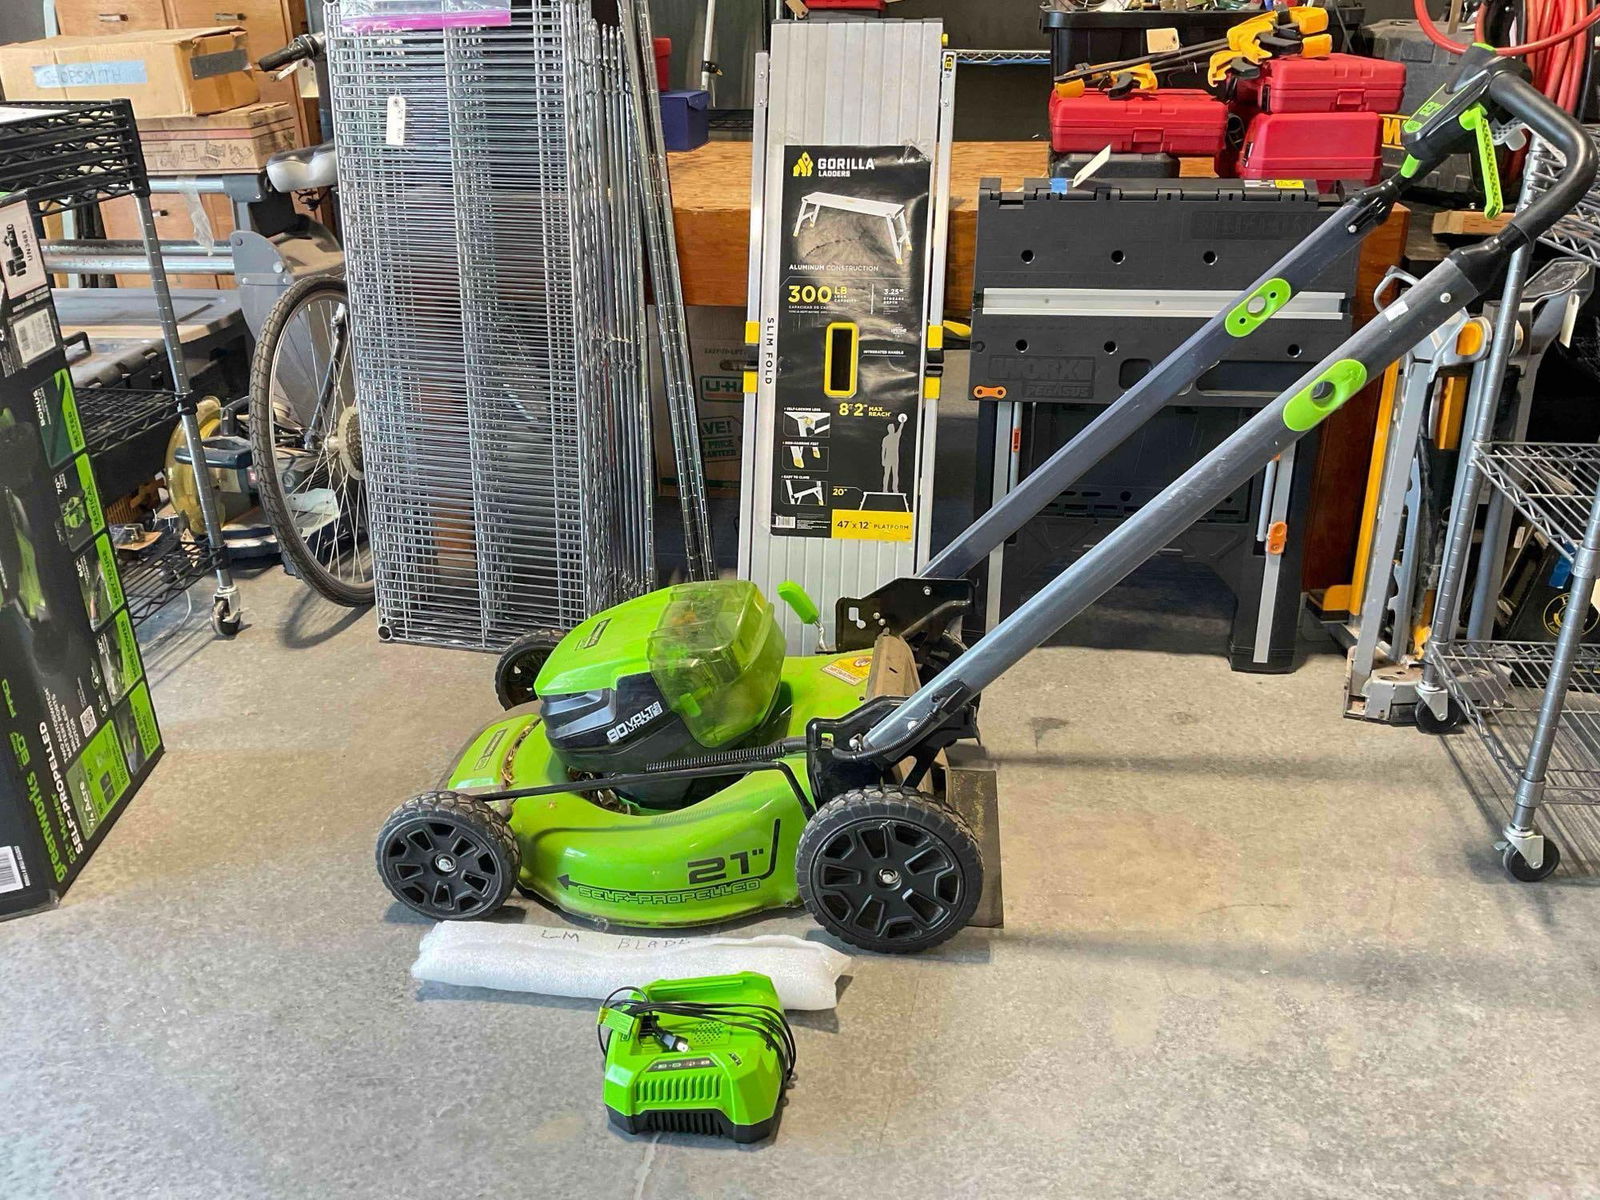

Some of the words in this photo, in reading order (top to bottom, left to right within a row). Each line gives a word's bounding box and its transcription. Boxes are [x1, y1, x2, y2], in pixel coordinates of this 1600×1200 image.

[44, 69, 121, 84] SHOPSMITH
[818, 158, 875, 170] GORILLA
[826, 264, 879, 272] CONSTRUCTION
[788, 285, 832, 303] 300
[834, 286, 848, 294] LB
[766, 317, 775, 346] SLIM
[765, 352, 774, 385] FOLD
[32, 390, 46, 427] BONUS
[60, 704, 77, 754] BRUSHLESS
[69, 717, 81, 749] MOTOR
[39, 721, 84, 855] SELF-PROPELLED
[26, 770, 68, 884] greenworks
[687, 848, 764, 884] 21"
[578, 878, 761, 904] SELF-PROPELLED
